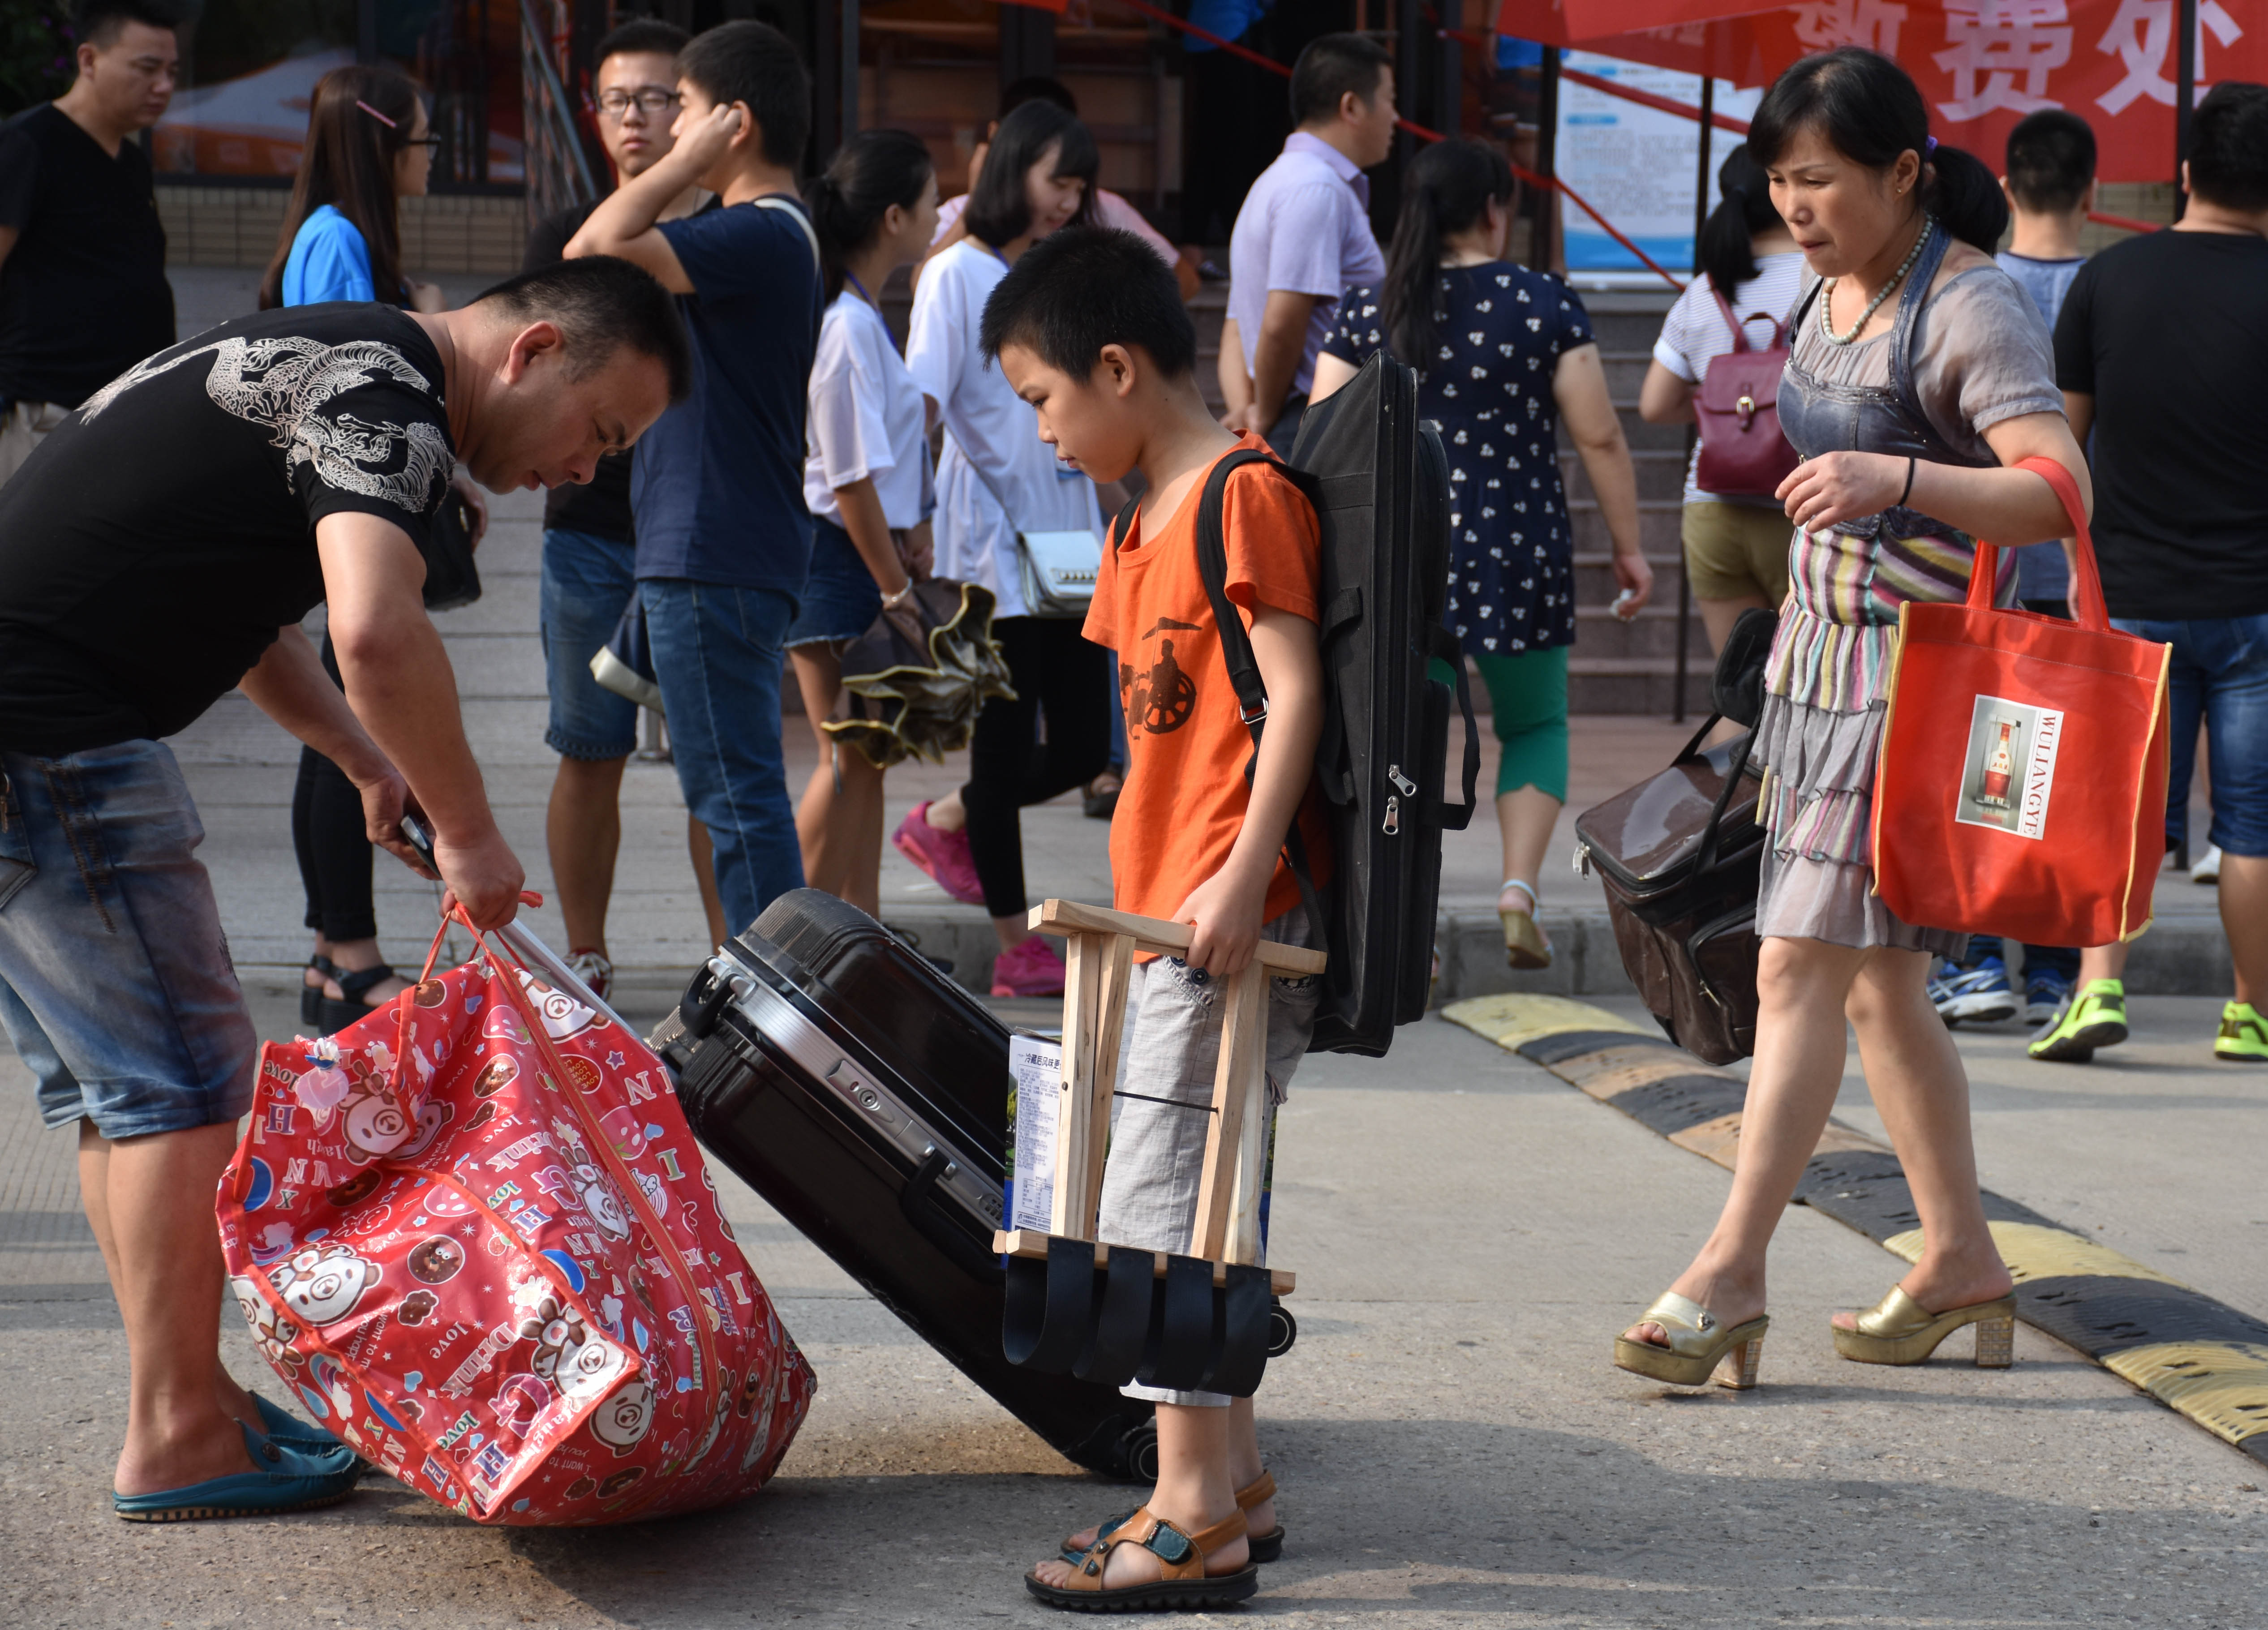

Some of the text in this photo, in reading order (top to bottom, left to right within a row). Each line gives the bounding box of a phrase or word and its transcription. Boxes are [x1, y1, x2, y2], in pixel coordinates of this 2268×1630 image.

[2022, 715, 2057, 836] WULIANGYE
[1024, 1053, 1061, 1070] 冷藏后风味更
[571, 1066, 588, 1078] LOVE
[575, 1071, 591, 1084] LOVE
[581, 1075, 599, 1089] LOVE
[483, 1114, 523, 1142] love
[487, 1180, 522, 1210] lov
[374, 1228, 402, 1253] love
[357, 1314, 373, 1334] you
[372, 1313, 388, 1341] want
[365, 1343, 378, 1355] to
[429, 1321, 468, 1359] love
[440, 1321, 518, 1400] Drink
[436, 1410, 481, 1451] love
[548, 1456, 560, 1468] to
[568, 1447, 590, 1458] you
[561, 1459, 584, 1471] want
